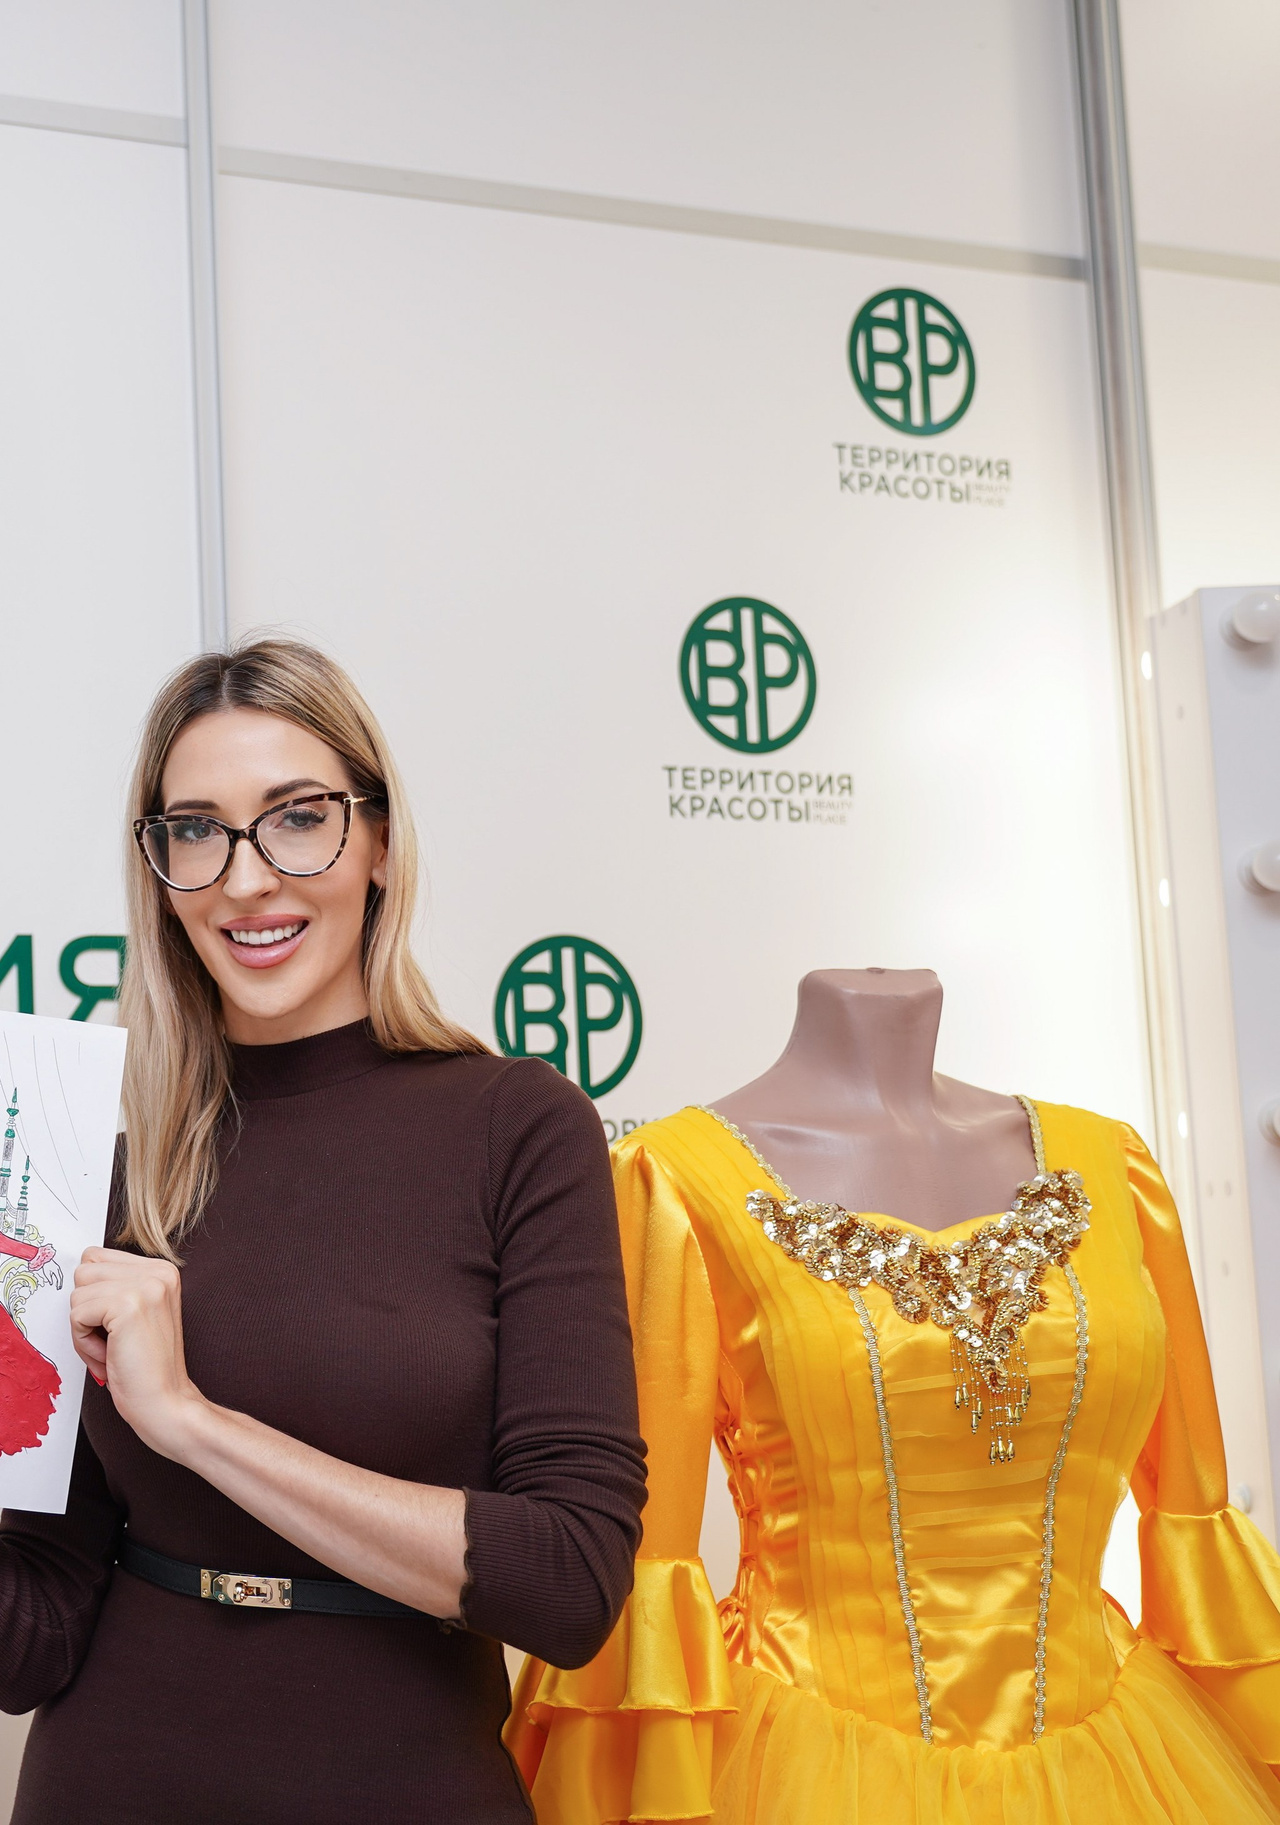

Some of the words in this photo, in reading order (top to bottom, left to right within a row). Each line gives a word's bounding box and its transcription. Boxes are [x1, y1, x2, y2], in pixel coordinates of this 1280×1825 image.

[833, 442, 1011, 481] ТЕРРИТОРИЯ
[838, 470, 970, 503] КРАСОТЫ
[662, 766, 853, 796] ТЕРРИТОРИЯ
[668, 794, 810, 822] КРАСОТЫ
